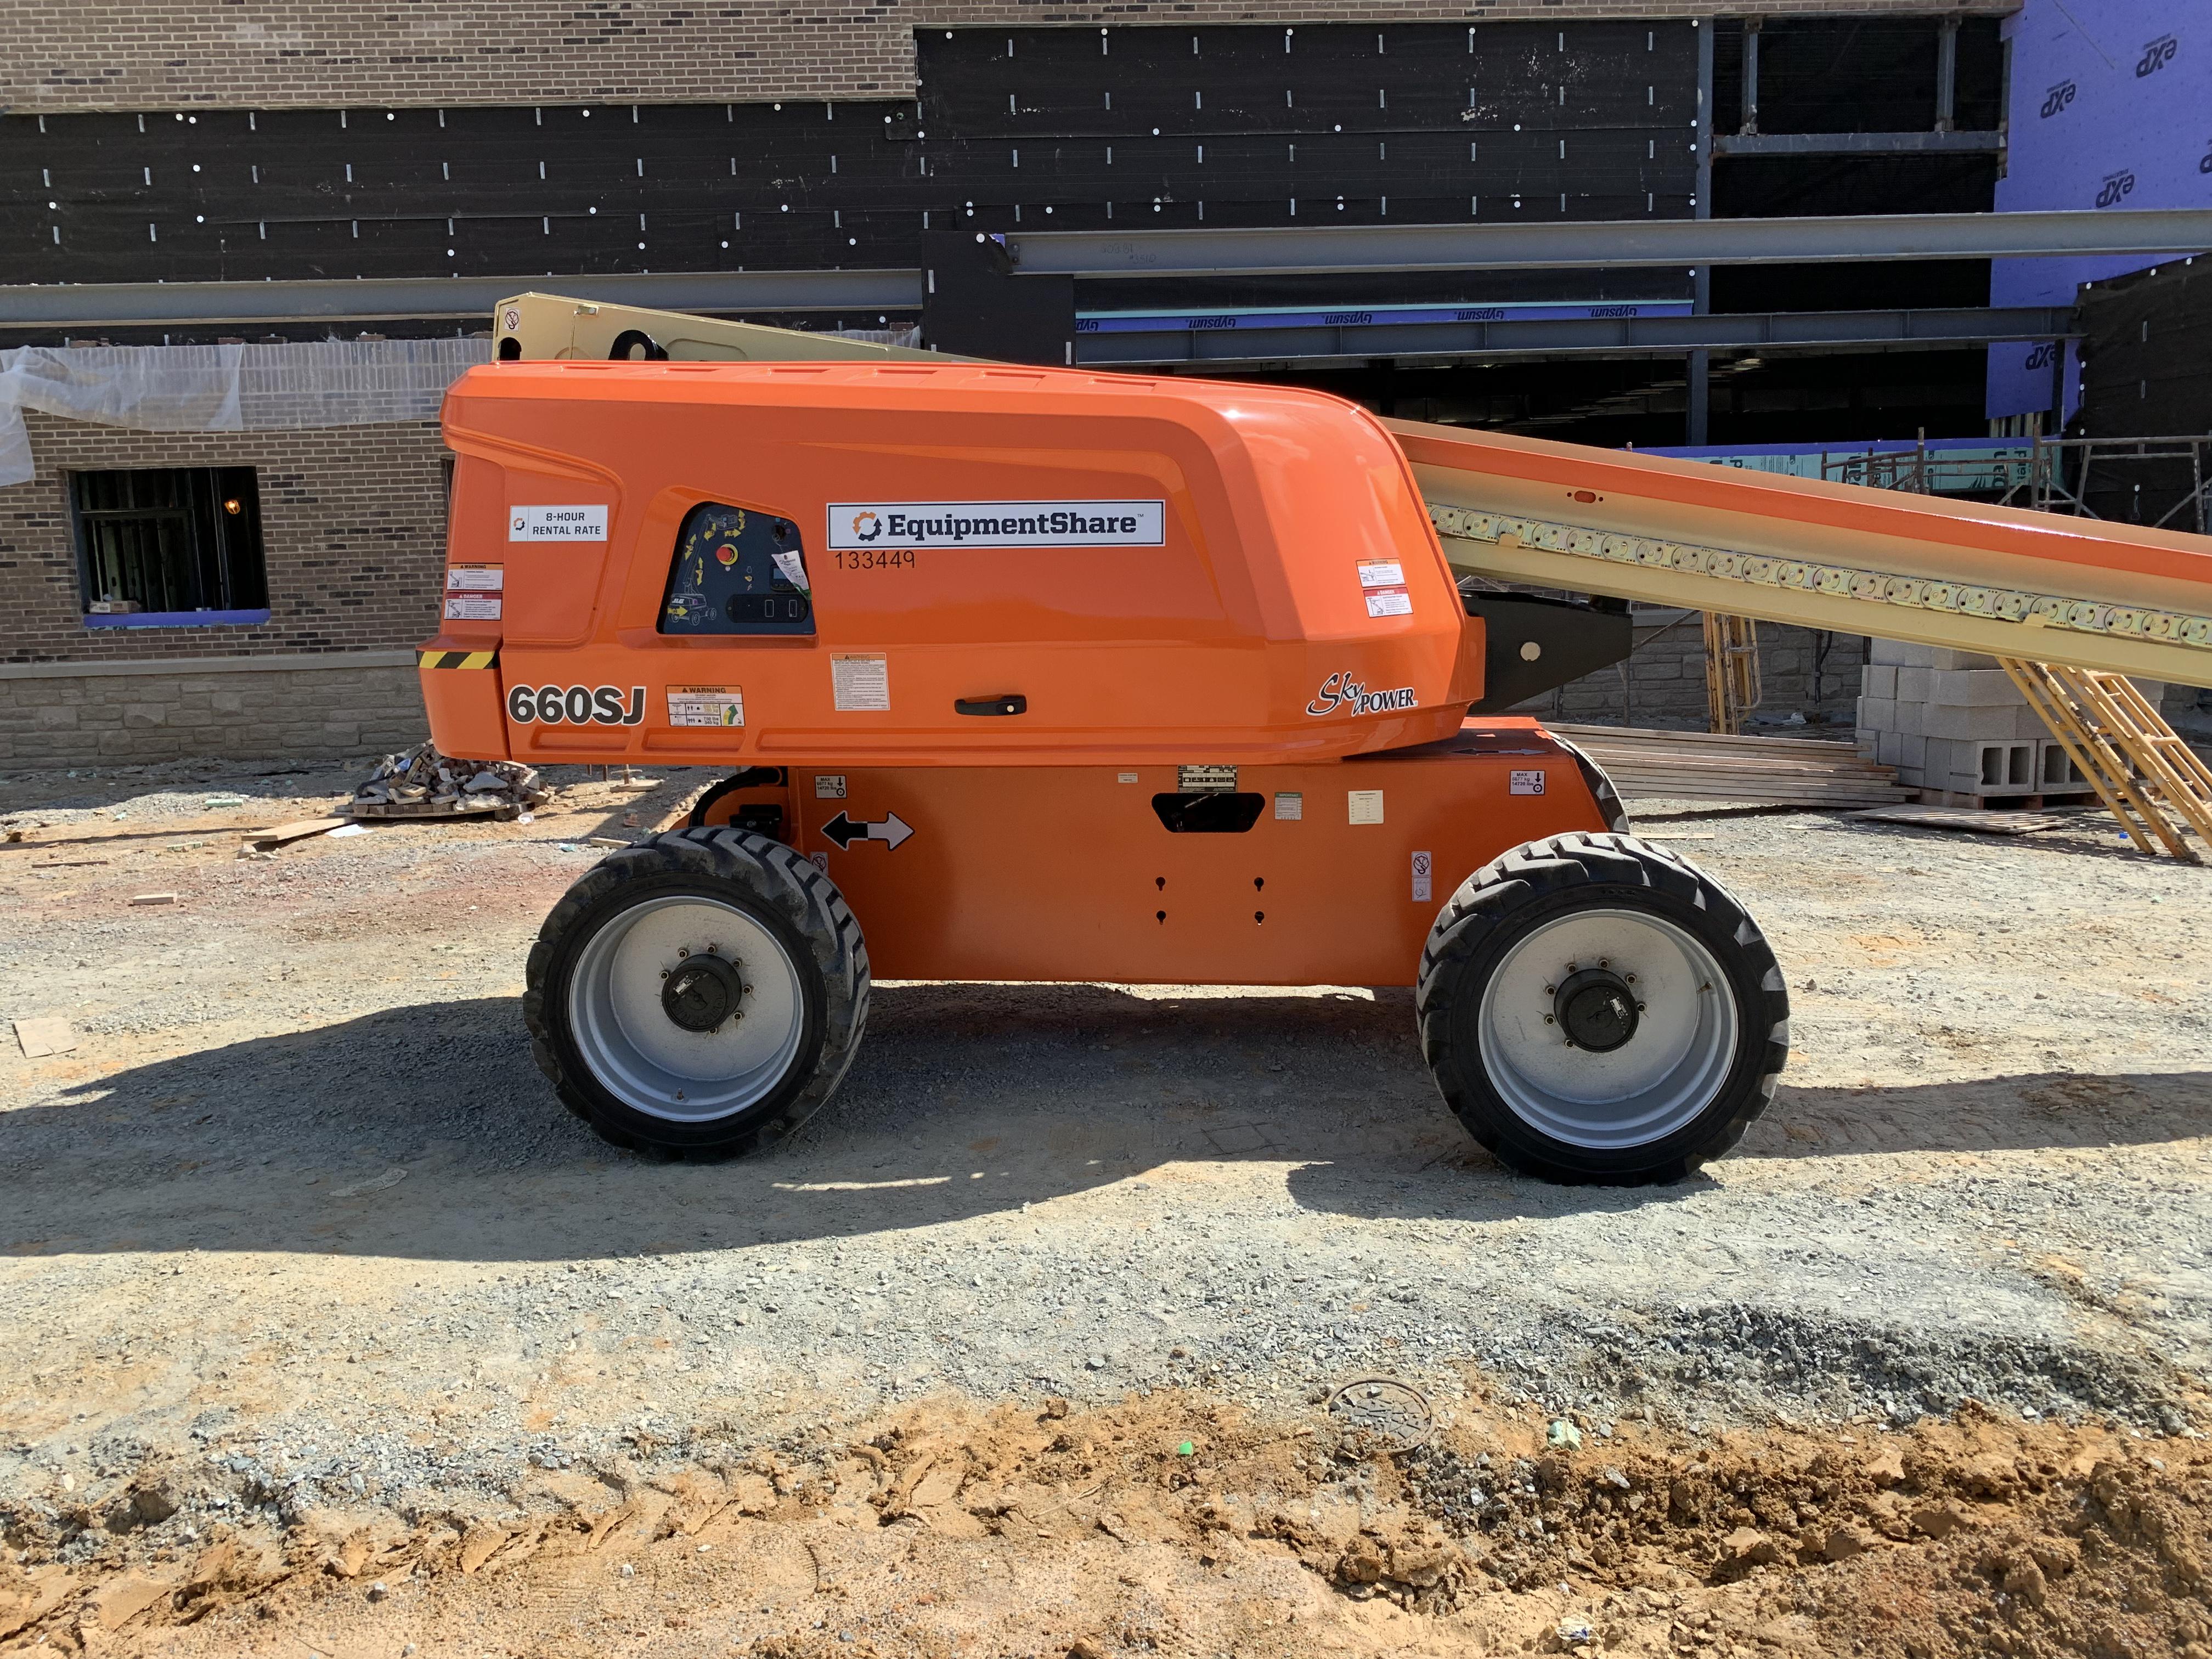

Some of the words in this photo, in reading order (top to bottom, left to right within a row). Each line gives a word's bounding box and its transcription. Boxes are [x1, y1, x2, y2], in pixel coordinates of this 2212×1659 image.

[546, 512, 585, 521] 8-HOUR
[888, 512, 1137, 541] EquipmentShare
[533, 526, 571, 535] RENTAL
[574, 526, 601, 535] RATE
[835, 550, 916, 570] 133449
[508, 685, 645, 725] 660SJ
[1307, 672, 1364, 715] Sky
[1360, 689, 1414, 713] POWER
